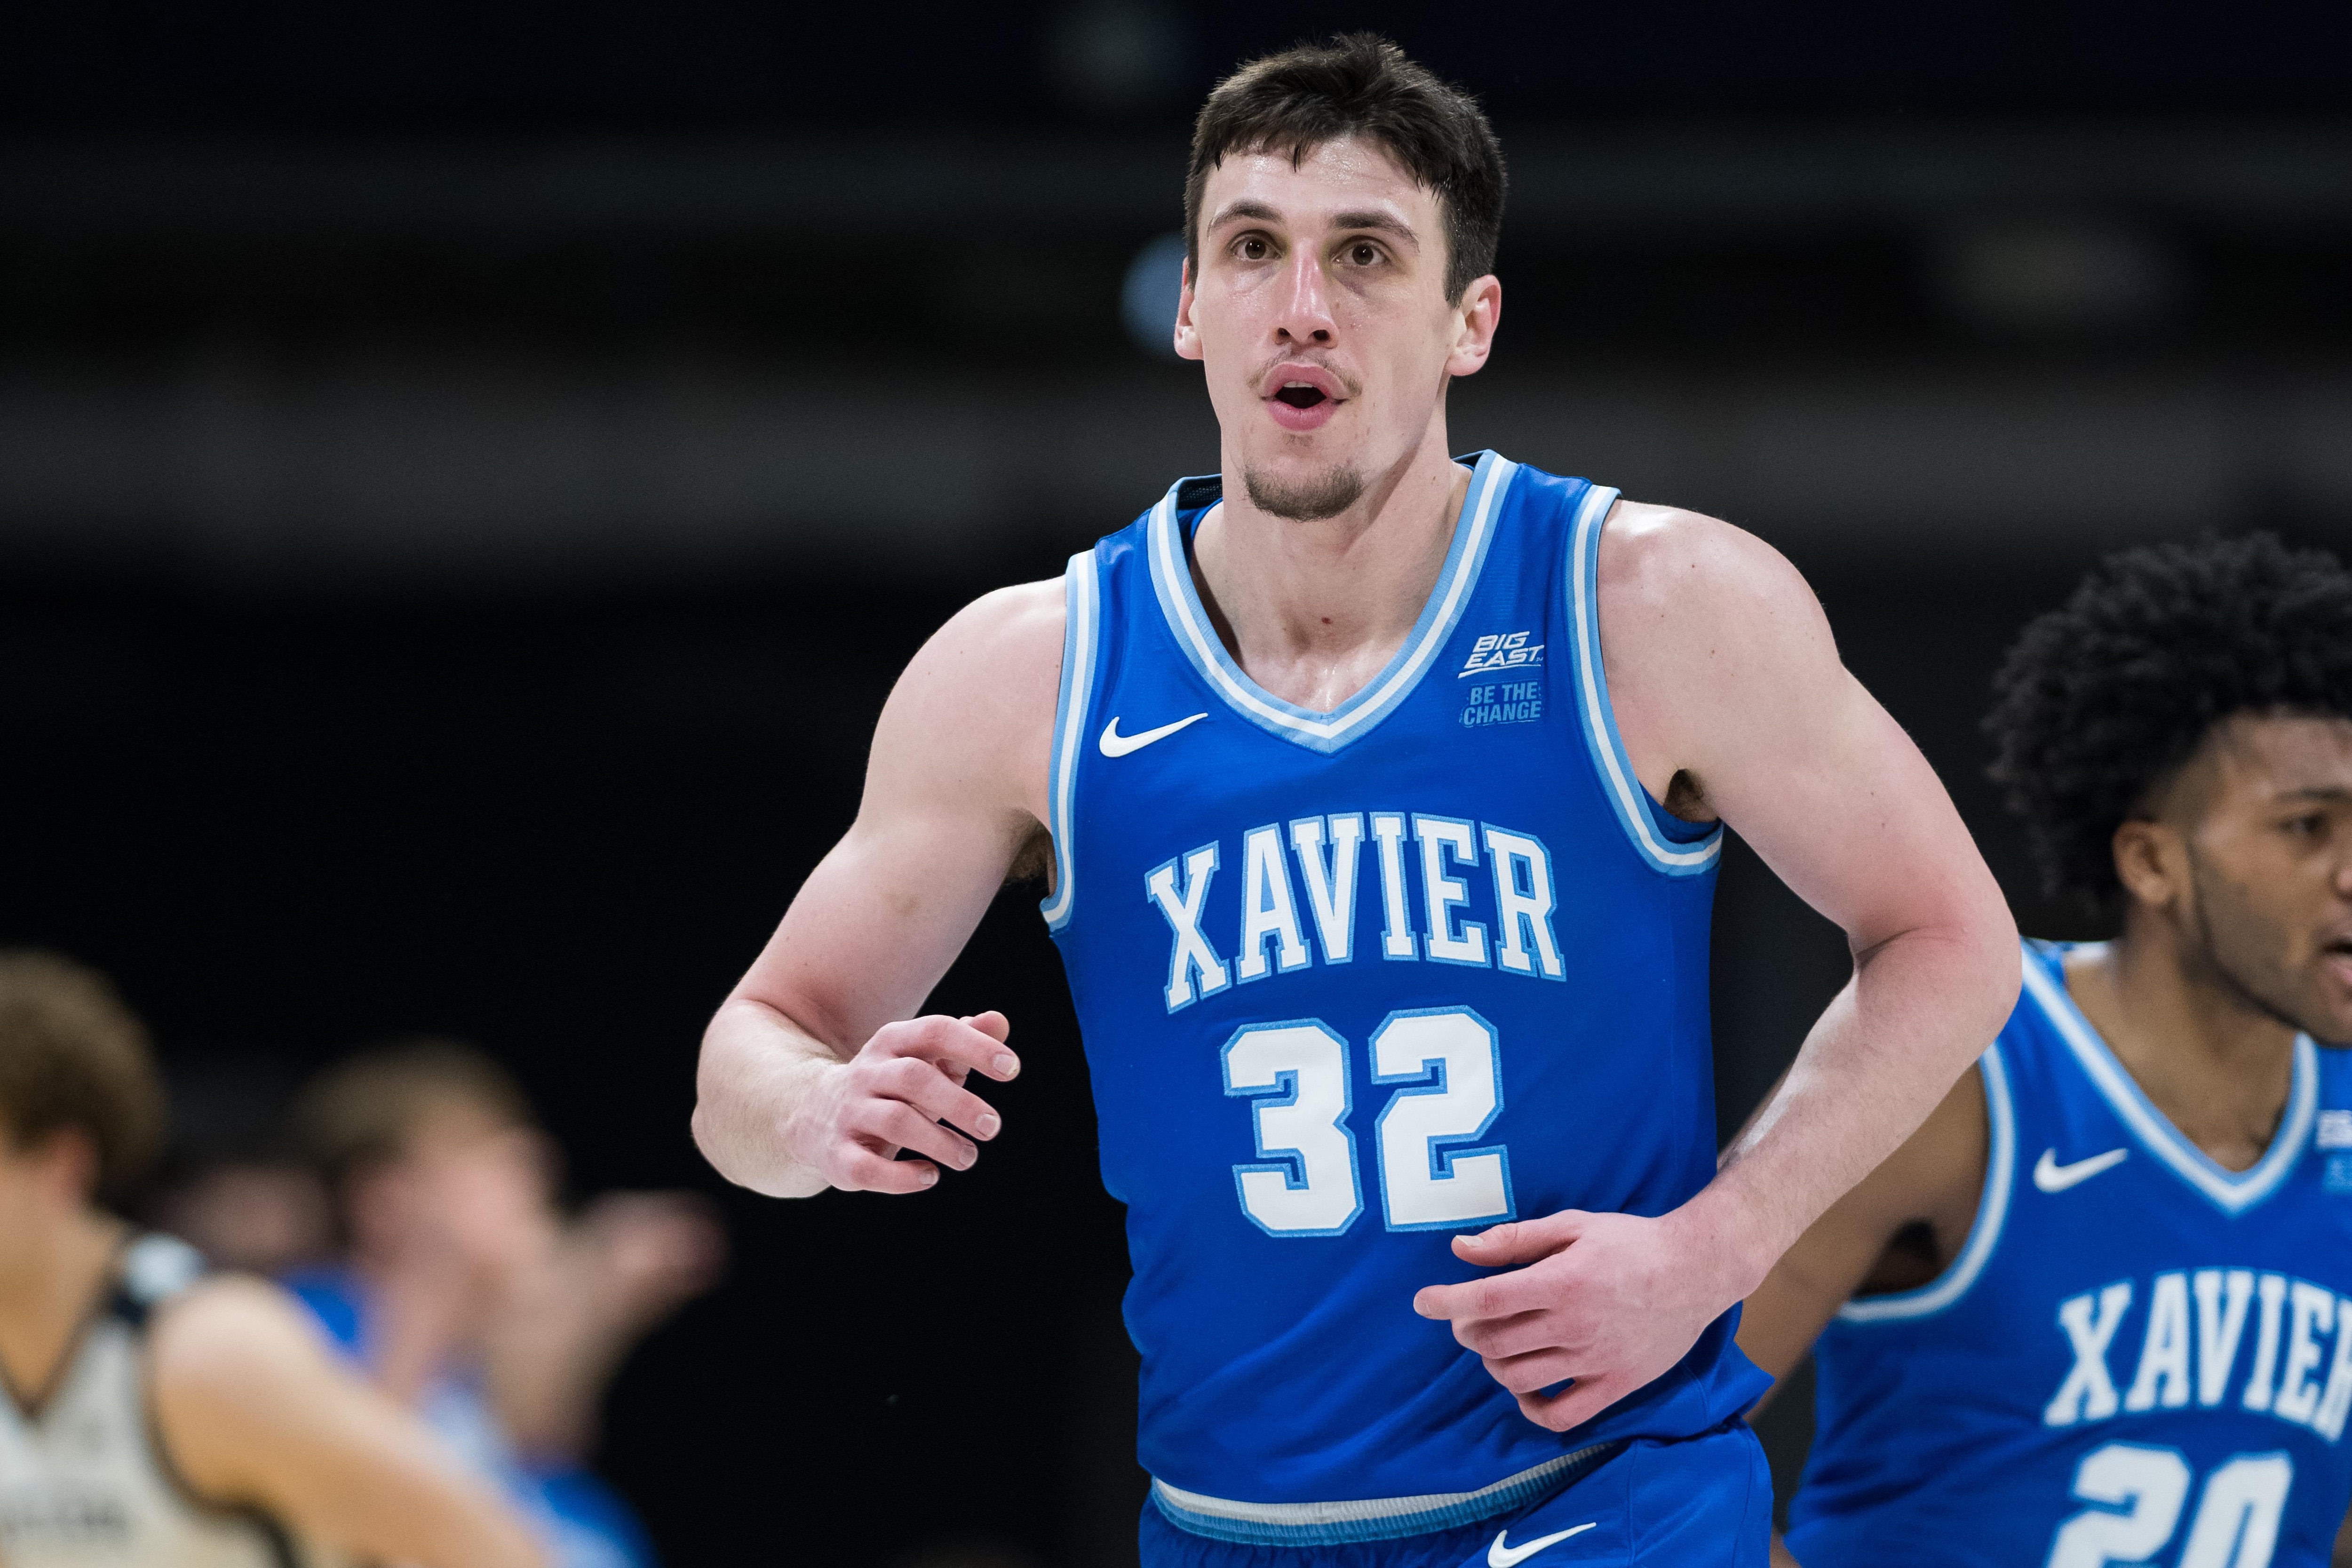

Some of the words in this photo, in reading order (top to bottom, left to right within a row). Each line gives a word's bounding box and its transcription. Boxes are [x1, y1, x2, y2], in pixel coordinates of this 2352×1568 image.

[1473, 631, 1530, 653] BIG
[1463, 645, 1544, 669] EAST
[1470, 685, 1495, 705] BE
[1502, 682, 1538, 702] THE
[1463, 701, 1542, 725] CHANGE
[1145, 812, 1567, 1014] XAVIER
[1220, 1005, 1517, 1237] 32
